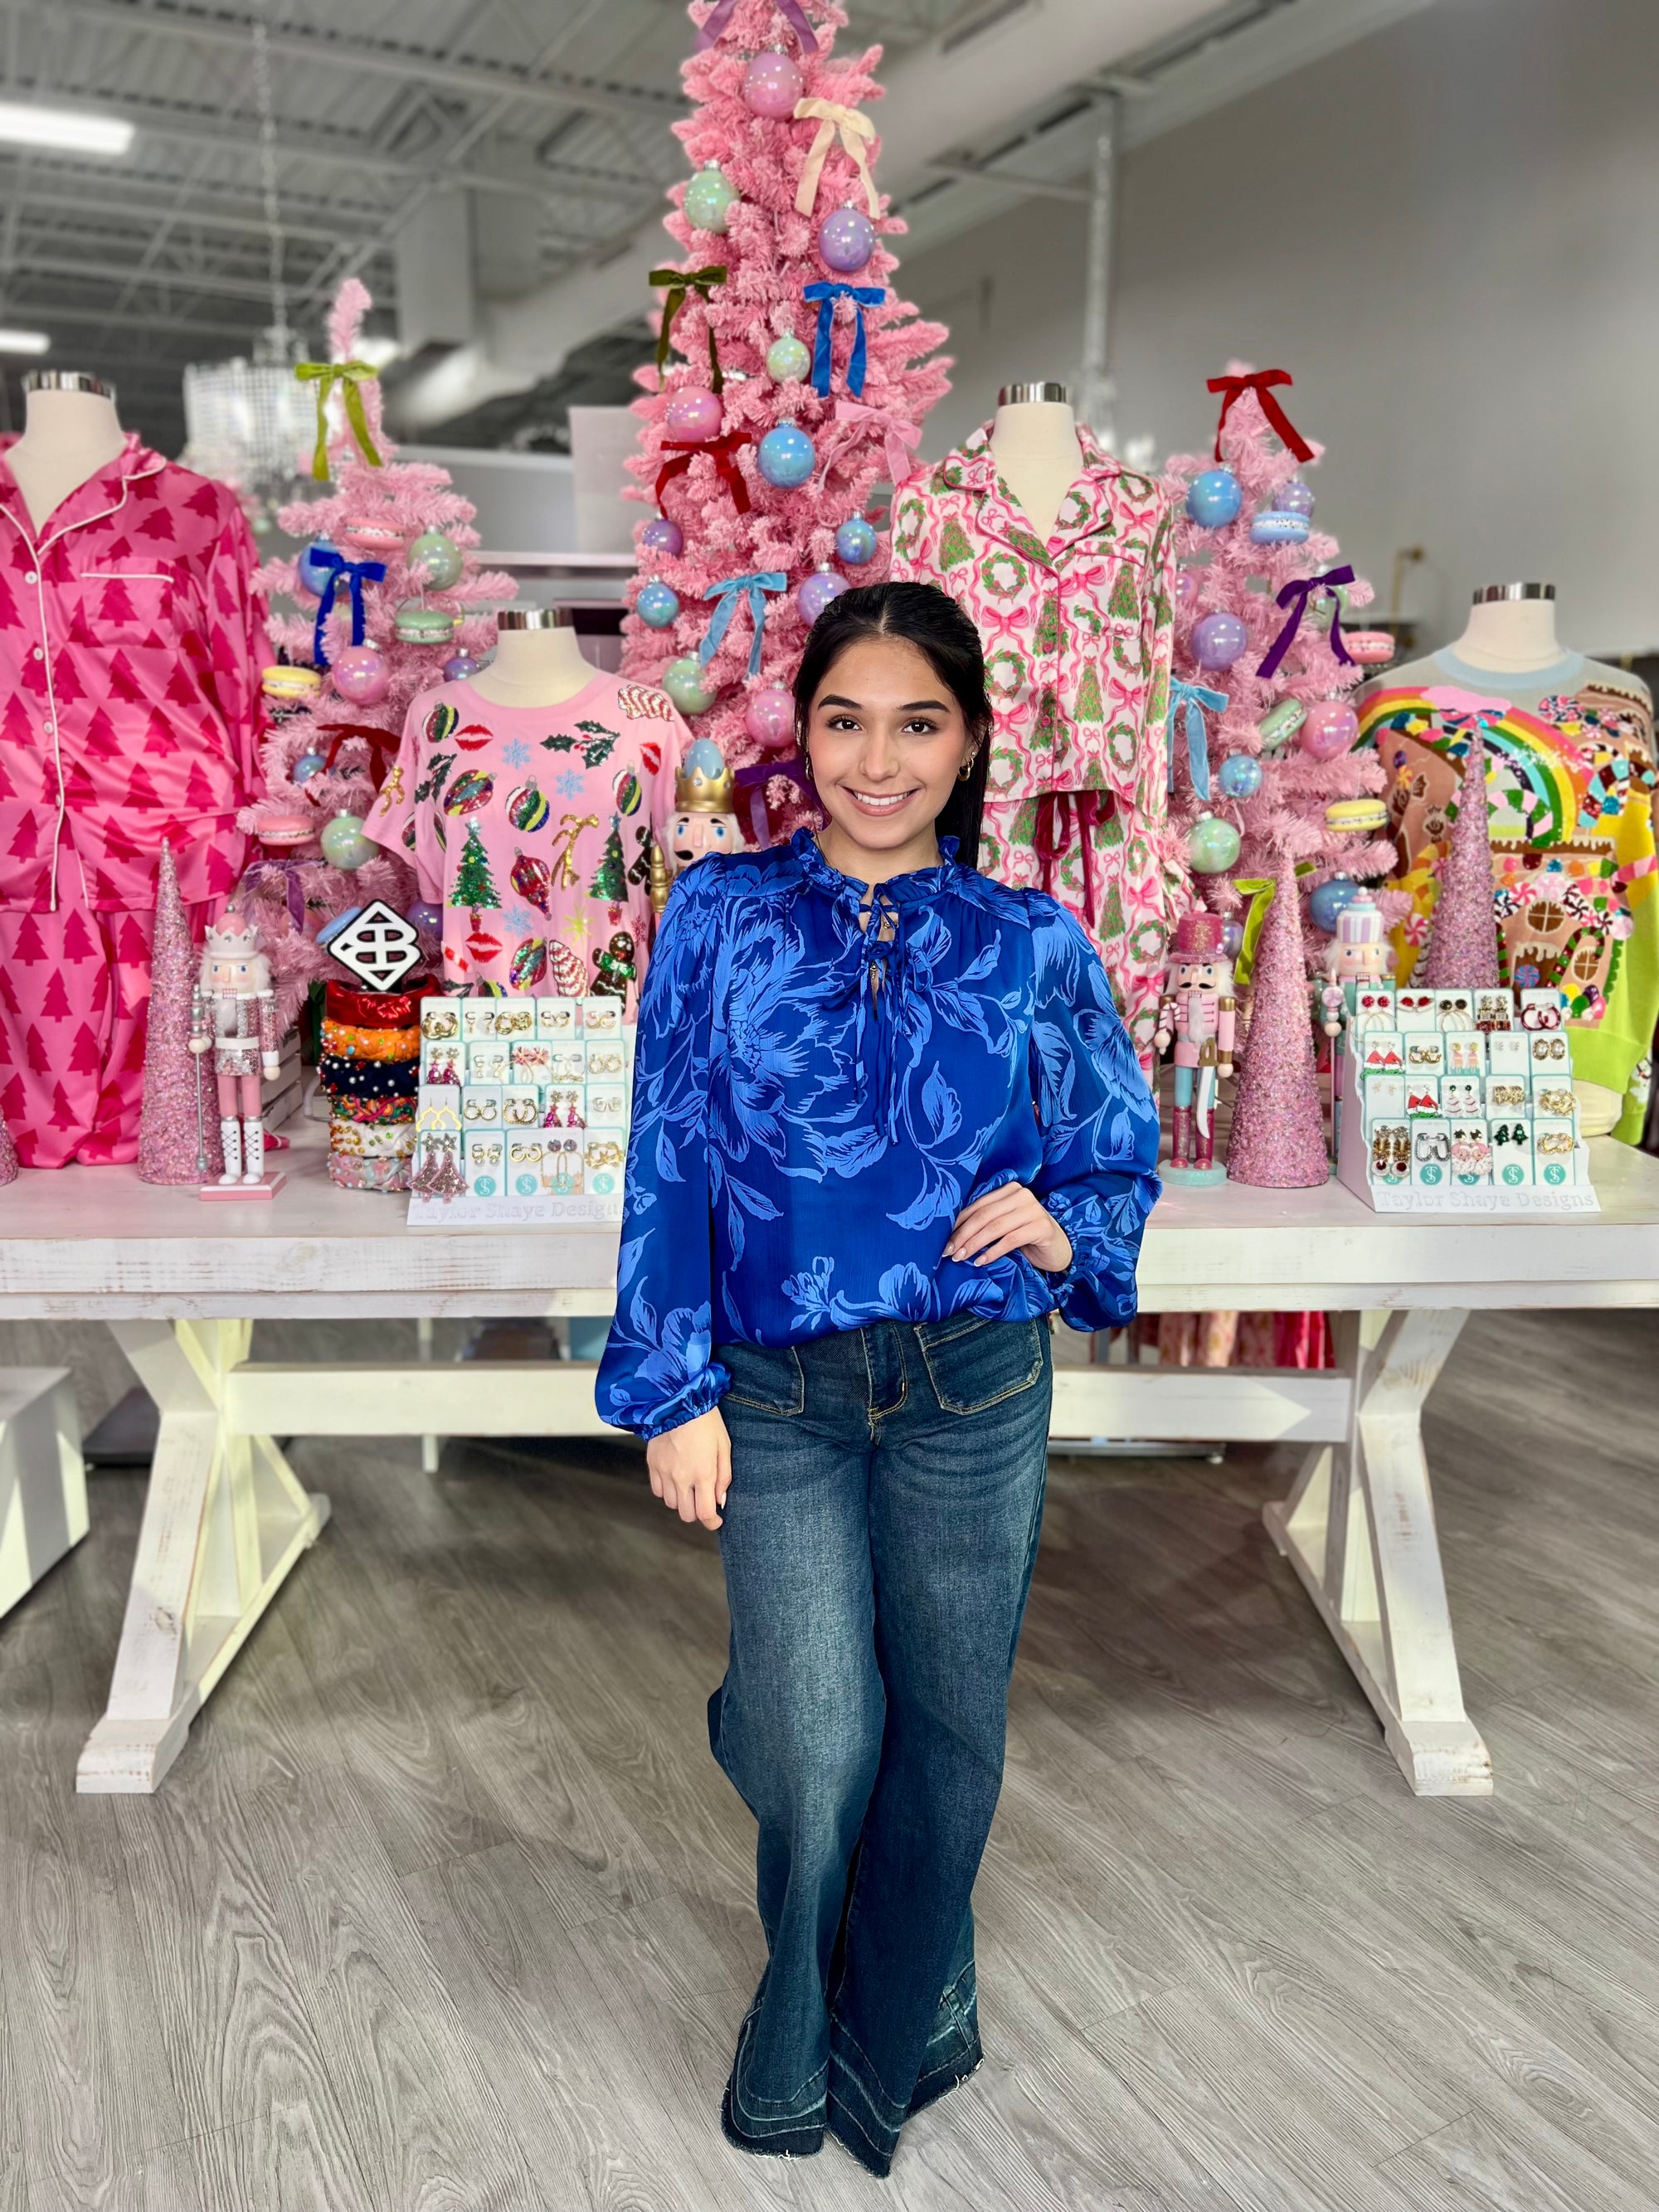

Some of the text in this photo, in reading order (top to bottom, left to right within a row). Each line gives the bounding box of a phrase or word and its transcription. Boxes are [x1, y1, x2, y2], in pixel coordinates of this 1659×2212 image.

[1376, 1191, 1593, 1211] Taylor Shaye Designs
[484, 1203, 544, 1222] Shaye
